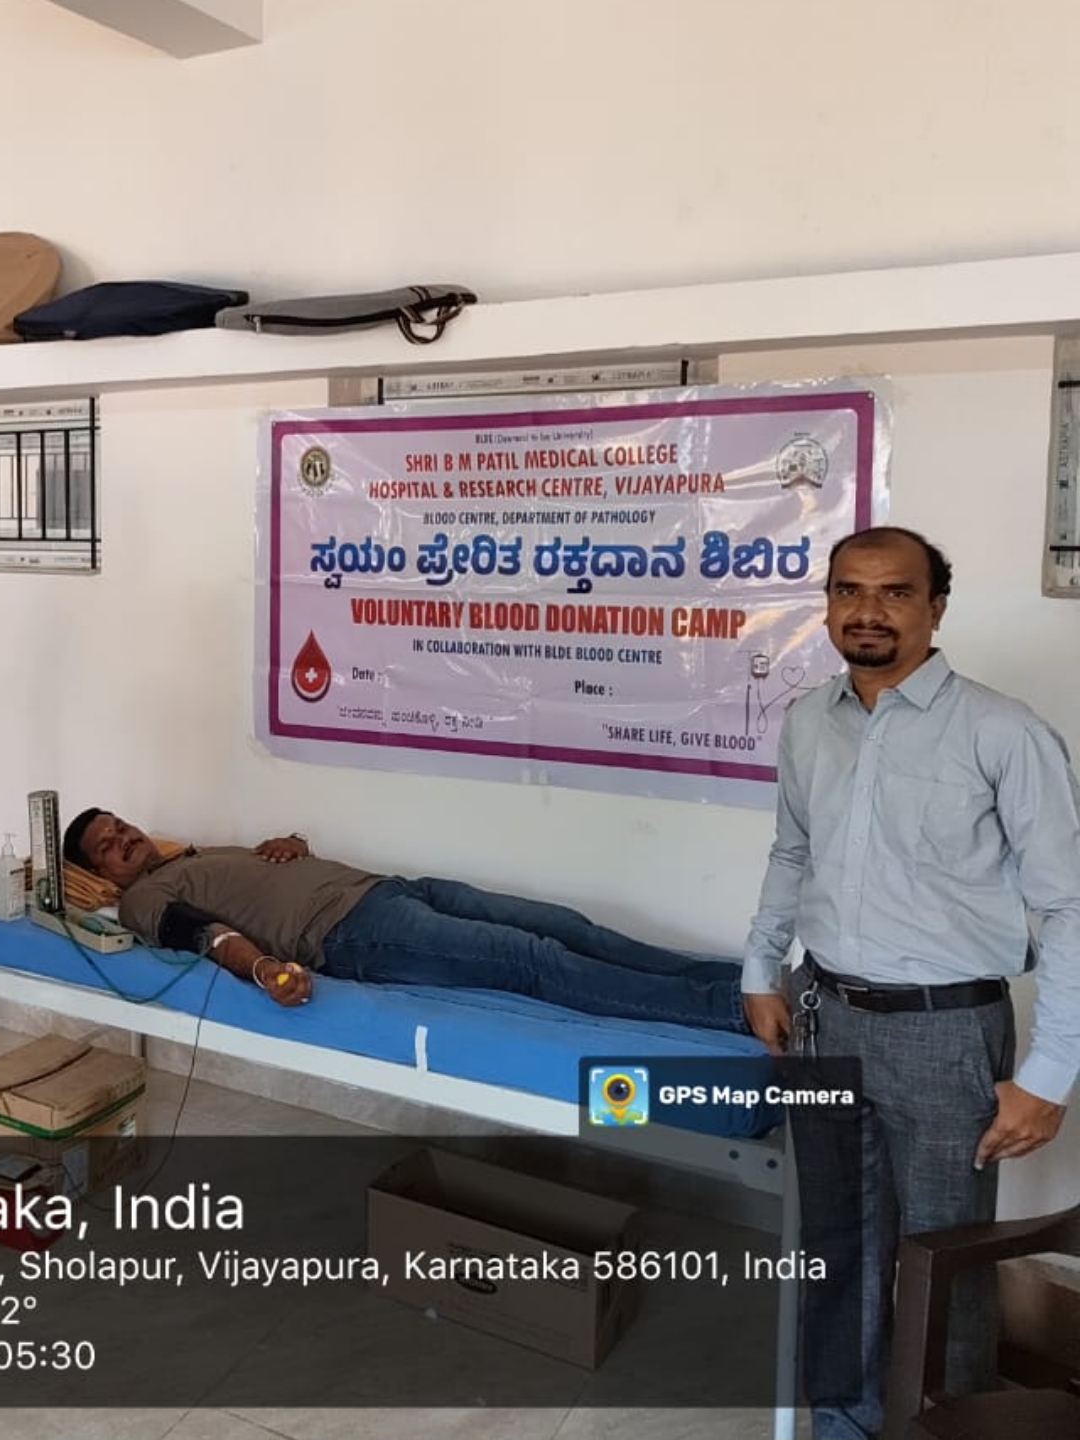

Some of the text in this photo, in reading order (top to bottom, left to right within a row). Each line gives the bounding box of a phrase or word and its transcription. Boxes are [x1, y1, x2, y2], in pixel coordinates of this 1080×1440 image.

[405, 443, 678, 472] SHRI B M PATIL MEDICAL COLLEGE
[369, 472, 726, 499] HOSPITAL & RESEARCH CENTRE, VIJAYAPURA
[423, 510, 656, 526] BLOOD CENTRE, DEPARTMENT OF PATHOLOGY
[310, 530, 811, 594] ಸ್ವಯಂ ಪ್ರೇರಿತ ರಕ್ತದಾನ ಶಿಬಿರ
[351, 598, 747, 639] VOLUNTARY BLOOD DONATION CAMP
[413, 638, 662, 665] IN COLLABORATION WITH BLDE BLOOD CENTRE
[352, 667, 374, 680] Date
[575, 680, 605, 696] Place
[649, 730, 676, 747] LIFE,
[681, 732, 711, 748] GIVE
